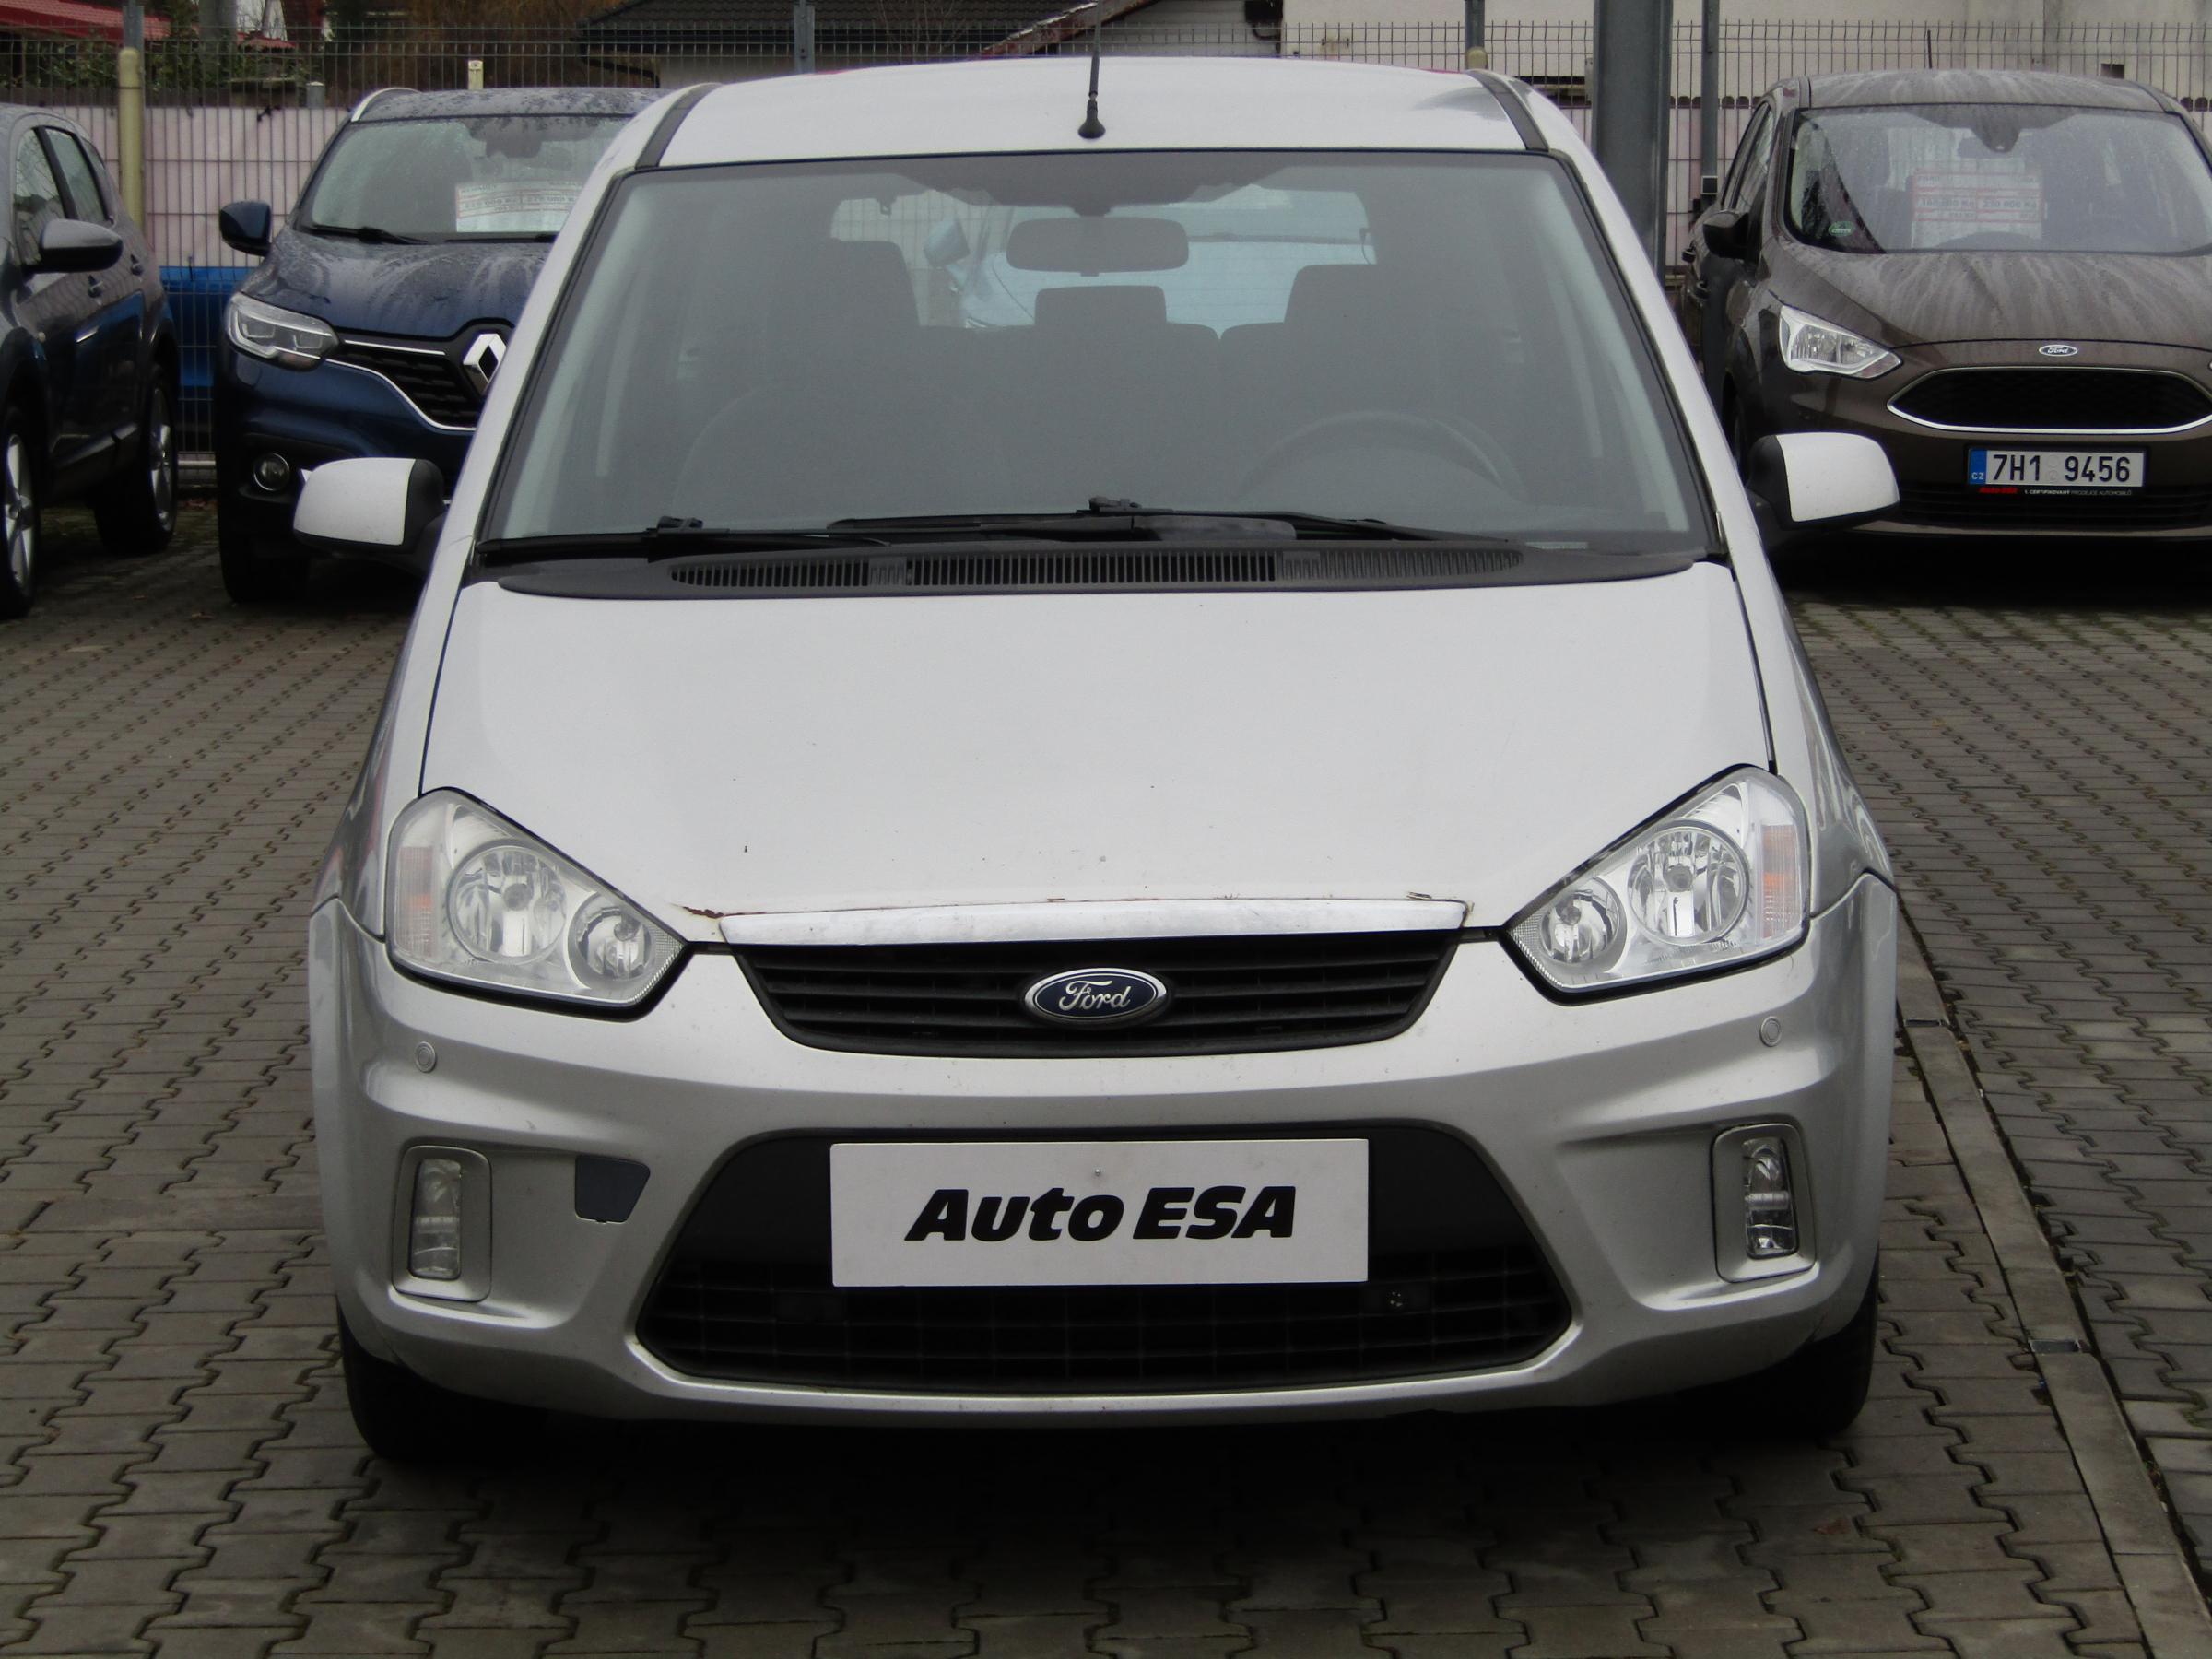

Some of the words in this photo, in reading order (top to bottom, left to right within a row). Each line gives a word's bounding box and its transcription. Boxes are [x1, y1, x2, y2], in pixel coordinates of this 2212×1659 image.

[1971, 472, 1984, 480] CZ
[1993, 454, 2041, 481] 7H1
[2064, 455, 2131, 482] 9456
[1059, 980, 1132, 1011] Ford
[904, 1187, 1124, 1241] Auto
[1133, 1185, 1296, 1240] ESA
